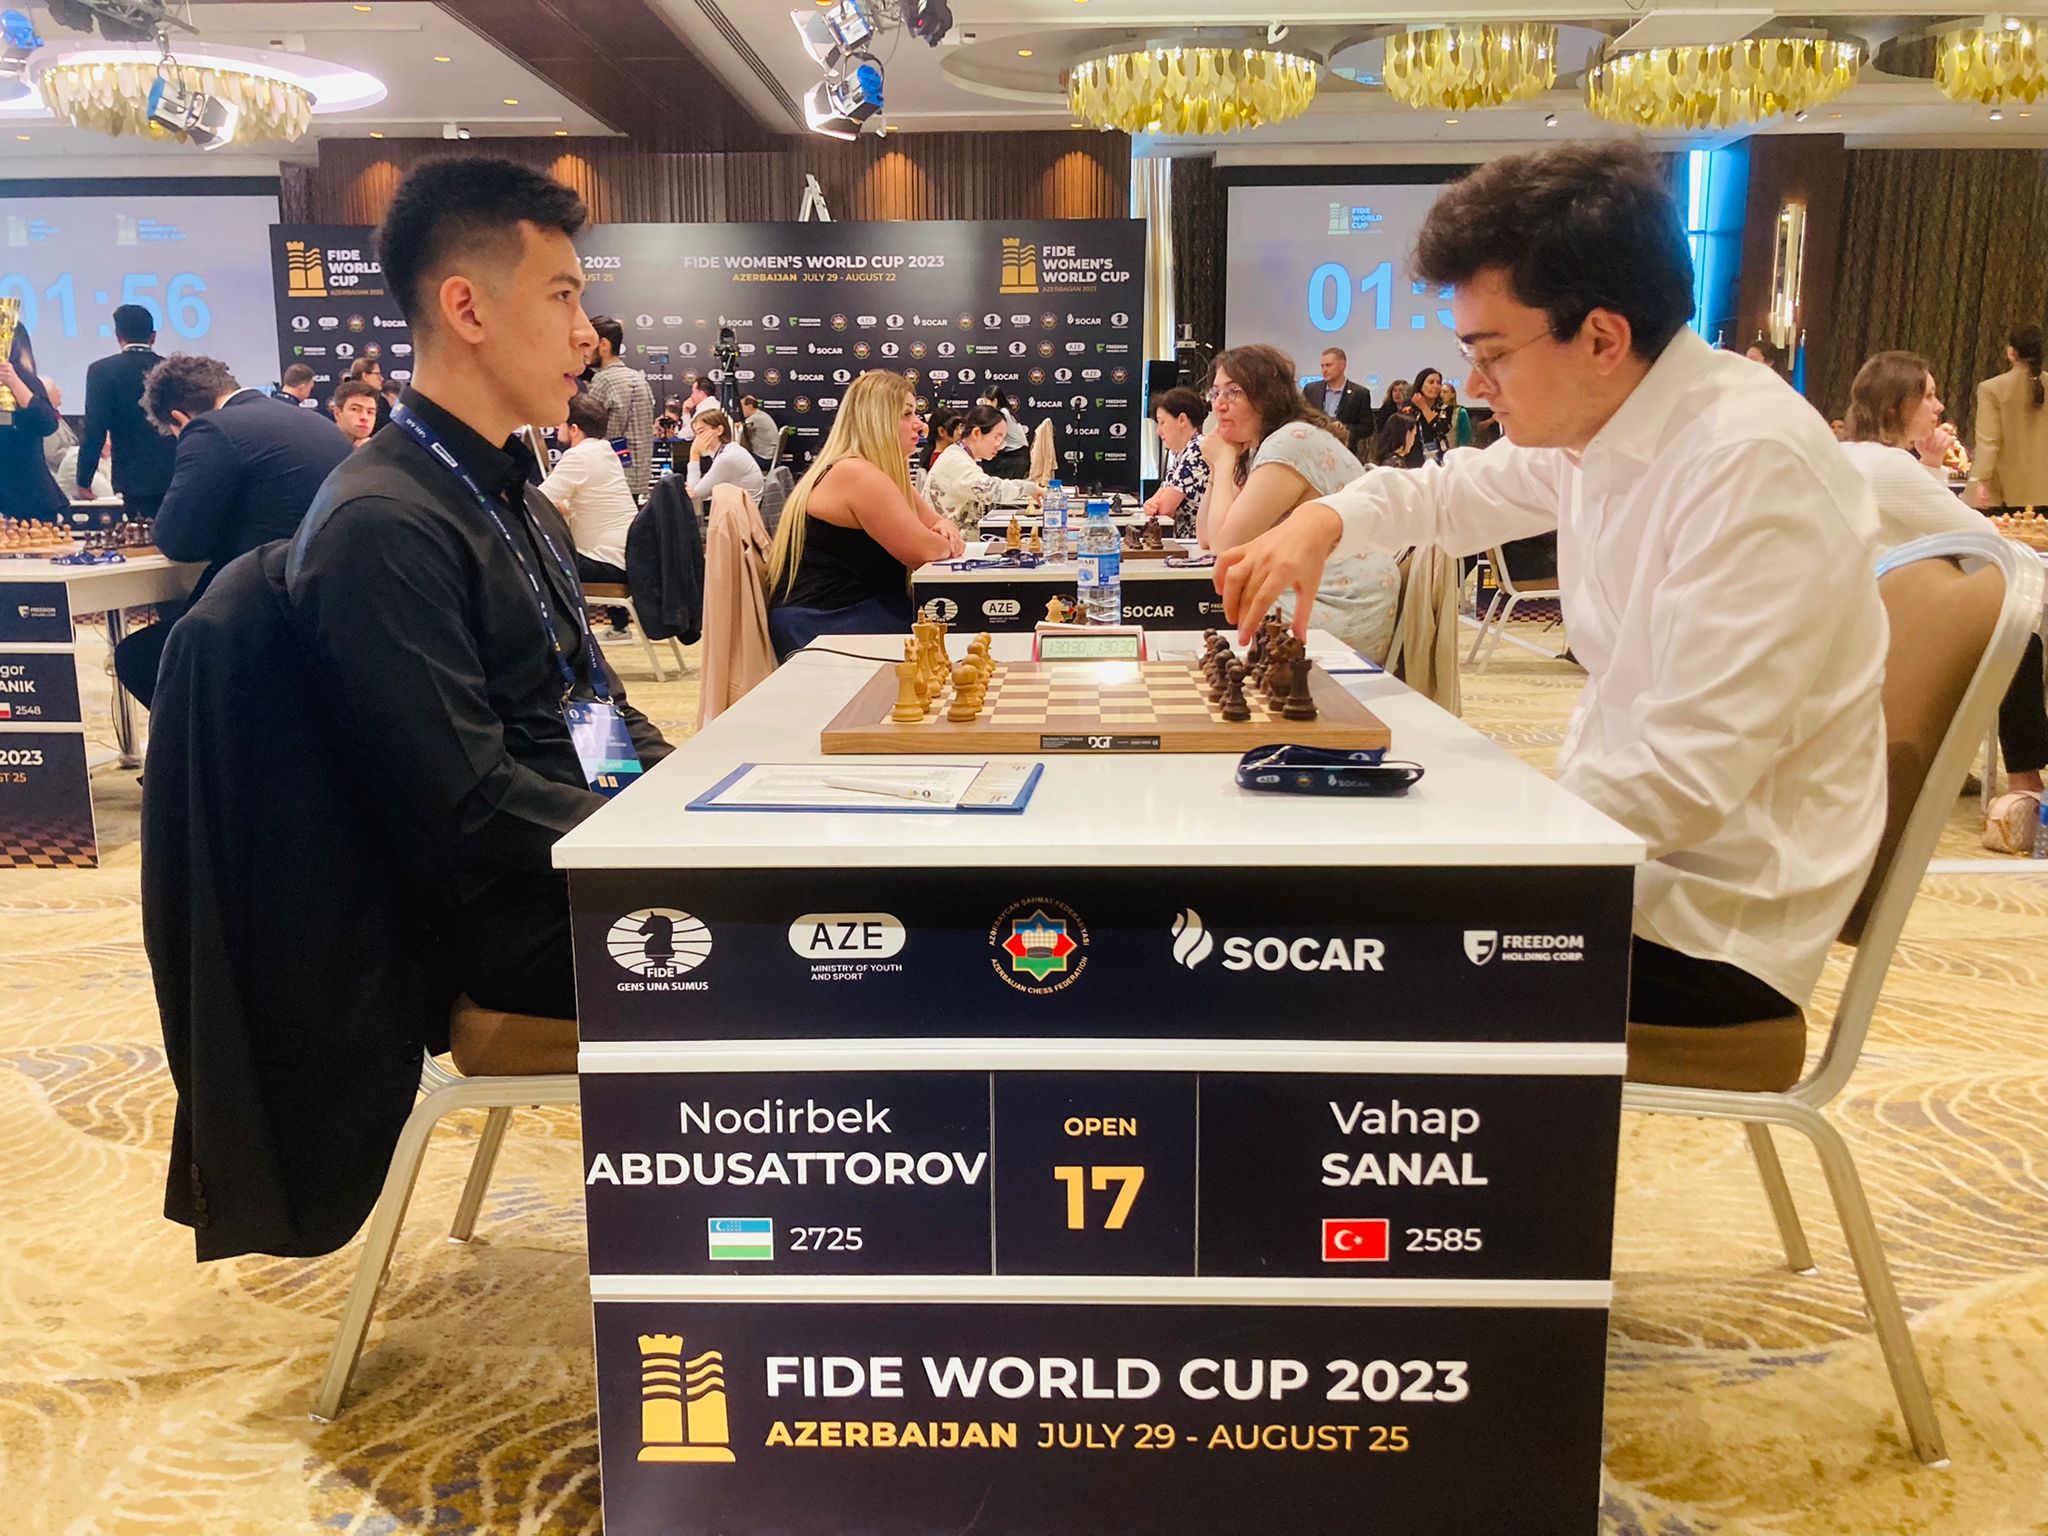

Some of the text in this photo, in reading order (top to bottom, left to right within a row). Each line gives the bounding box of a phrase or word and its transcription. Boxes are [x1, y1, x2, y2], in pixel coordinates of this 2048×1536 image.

[327, 250, 360, 261] FIDE
[1043, 246, 1076, 257] FIDE
[328, 262, 382, 274] WORLD
[584, 256, 621, 269] 2023
[684, 255, 945, 269] FIDE WOMEN'S WORLD CUP 2023
[1042, 258, 1113, 270] WOMEN'S
[329, 275, 359, 287] CUP
[732, 274, 797, 282] AZERBAIJAN
[802, 273, 825, 282] JULY
[827, 273, 838, 282] 29
[845, 273, 883, 282] AUGUST
[885, 273, 897, 282] 22
[1042, 271, 1130, 283] WORLD CUP
[382, 320, 408, 328] SOCA
[726, 319, 753, 327] SOCAR
[816, 347, 843, 355] SOCAR
[797, 373, 825, 381] SOCAR
[993, 373, 1019, 381] SOCAR
[1036, 400, 1063, 408] SOCAR
[988, 603, 1014, 613] AZE
[1122, 606, 1175, 618] SOCAR
[0, 665, 25, 678] gor
[0, 680, 36, 693] ANIK
[15, 705, 41, 716] 2548
[0, 749, 44, 766] 2023
[809, 922, 883, 950] AZE
[1502, 934, 1584, 950] FREEDOM
[1221, 936, 1385, 972] SOCAR
[1502, 952, 1551, 961] HOLDING
[646, 967, 675, 978] FIDE
[811, 964, 903, 973] MINISTRY OF YOUTH
[811, 973, 863, 981] AND SPORT
[1027, 985, 1053, 995] CHESS
[1054, 956, 1089, 992] FEDERATION
[617, 981, 709, 992] GENS UNA SUMUS
[680, 1099, 892, 1134] Nodirbek
[1329, 1099, 1481, 1142] Vahap
[1064, 1117, 1137, 1137] OPEN
[585, 1151, 987, 1186] ABDUSATTOROV
[1321, 1152, 1488, 1187] SANAL
[1054, 1166, 1145, 1230] 17
[790, 1227, 863, 1251] 2725
[1405, 1228, 1482, 1252] 2585
[766, 1355, 1470, 1403] FIDE WORLD CUP 2023
[765, 1421, 1018, 1449] AZERBAIJAN
[1037, 1422, 1126, 1450] JULY
[1134, 1423, 1176, 1450] 29
[1207, 1423, 1360, 1452] AUGUST
[1368, 1425, 1409, 1452] 25
